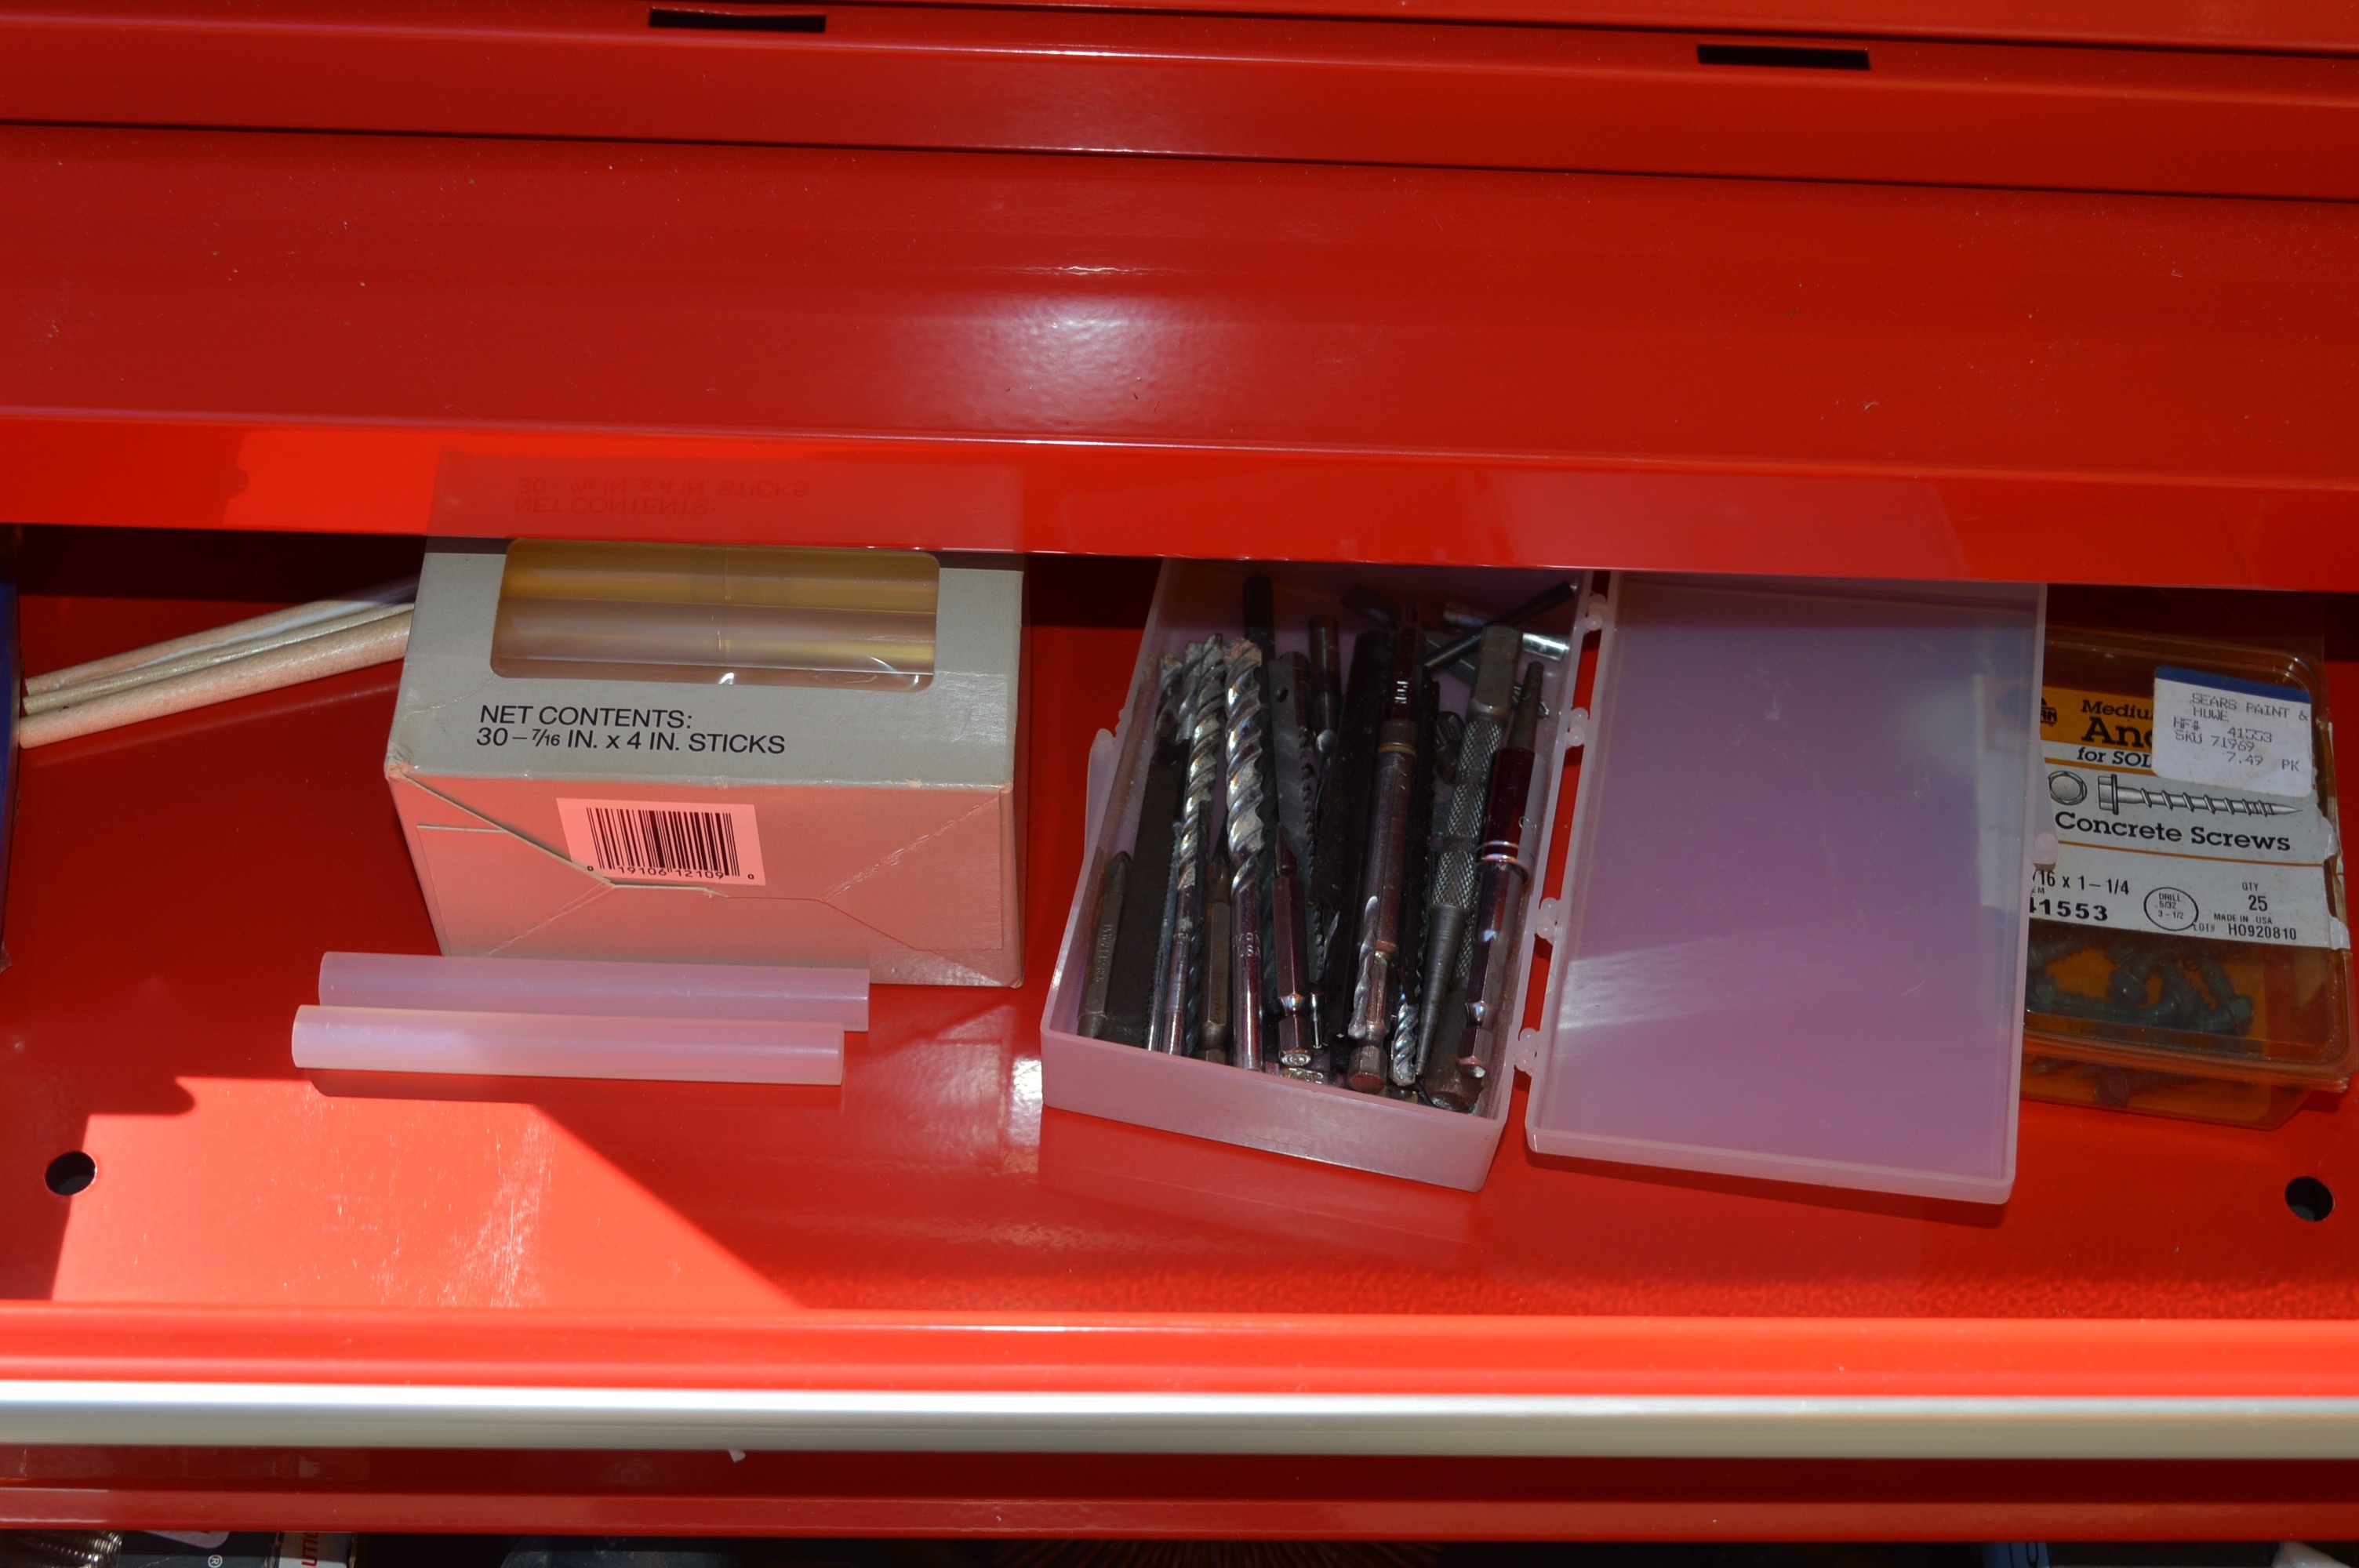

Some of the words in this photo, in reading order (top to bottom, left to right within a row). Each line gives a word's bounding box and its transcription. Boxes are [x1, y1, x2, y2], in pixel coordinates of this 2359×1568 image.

[2191, 693, 2237, 710] SEARS
[2246, 701, 2290, 719] PAINT
[2299, 710, 2308, 721] &
[480, 705, 534, 724] NET
[539, 706, 692, 729] CONTENTS:
[2173, 717, 2201, 731] HF#
[2227, 726, 2273, 743] 41553
[567, 729, 598, 749] IN.
[605, 735, 621, 750] x
[627, 731, 642, 750] 4
[649, 731, 680, 751] IN.
[688, 732, 786, 754] STICKS
[2174, 729, 2203, 745] SKU
[2211, 735, 2255, 753] 71969
[2077, 746, 2106, 763] for
[2227, 750, 2264, 767] 7.49
[2281, 759, 2299, 772] PK
[2055, 811, 2183, 842] Concrete
[2190, 826, 2291, 851] Screws
[618, 866, 668, 877] 19106
[675, 869, 725, 880] 12109
[2062, 876, 2070, 888] x
[2242, 882, 2259, 891] QTY
[2158, 892, 2181, 902] DRILL
[2159, 900, 2177, 909] 5/32
[2248, 894, 2268, 912] 25
[2213, 913, 2237, 922] MADE
[2240, 914, 2249, 923] IN
